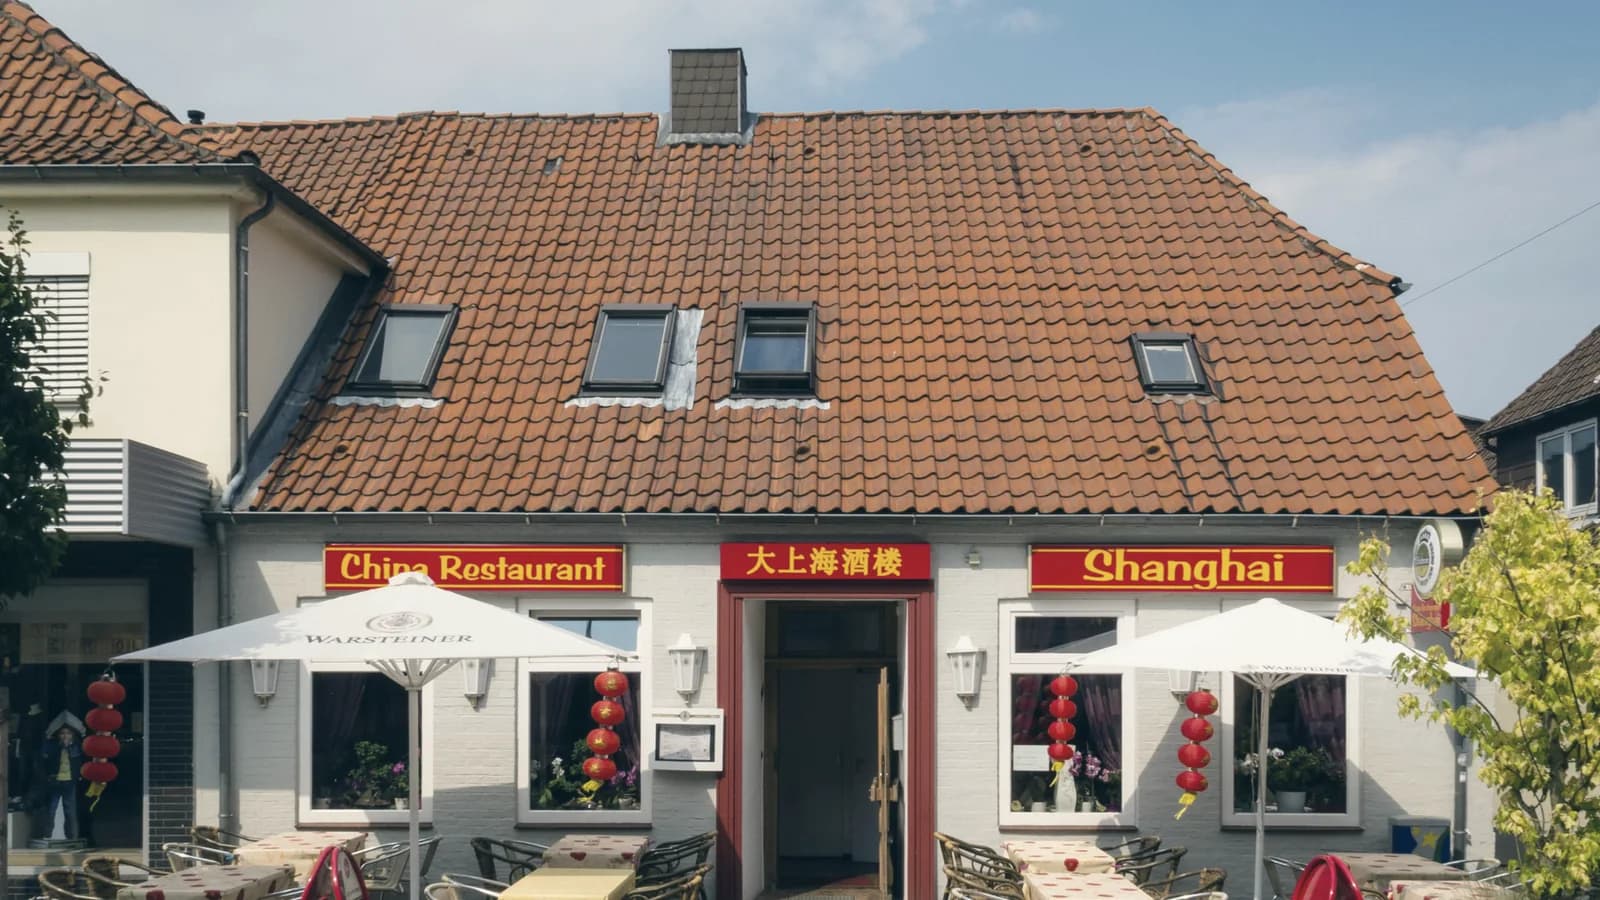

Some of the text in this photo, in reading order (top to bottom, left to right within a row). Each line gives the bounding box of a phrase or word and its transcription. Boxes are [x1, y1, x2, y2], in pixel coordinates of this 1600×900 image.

[440, 555, 606, 581] Restaurant
[746, 545, 902, 576] 大上海酒楼
[1083, 548, 1284, 590] Shanghai
[305, 634, 474, 645] WARSTEINER
